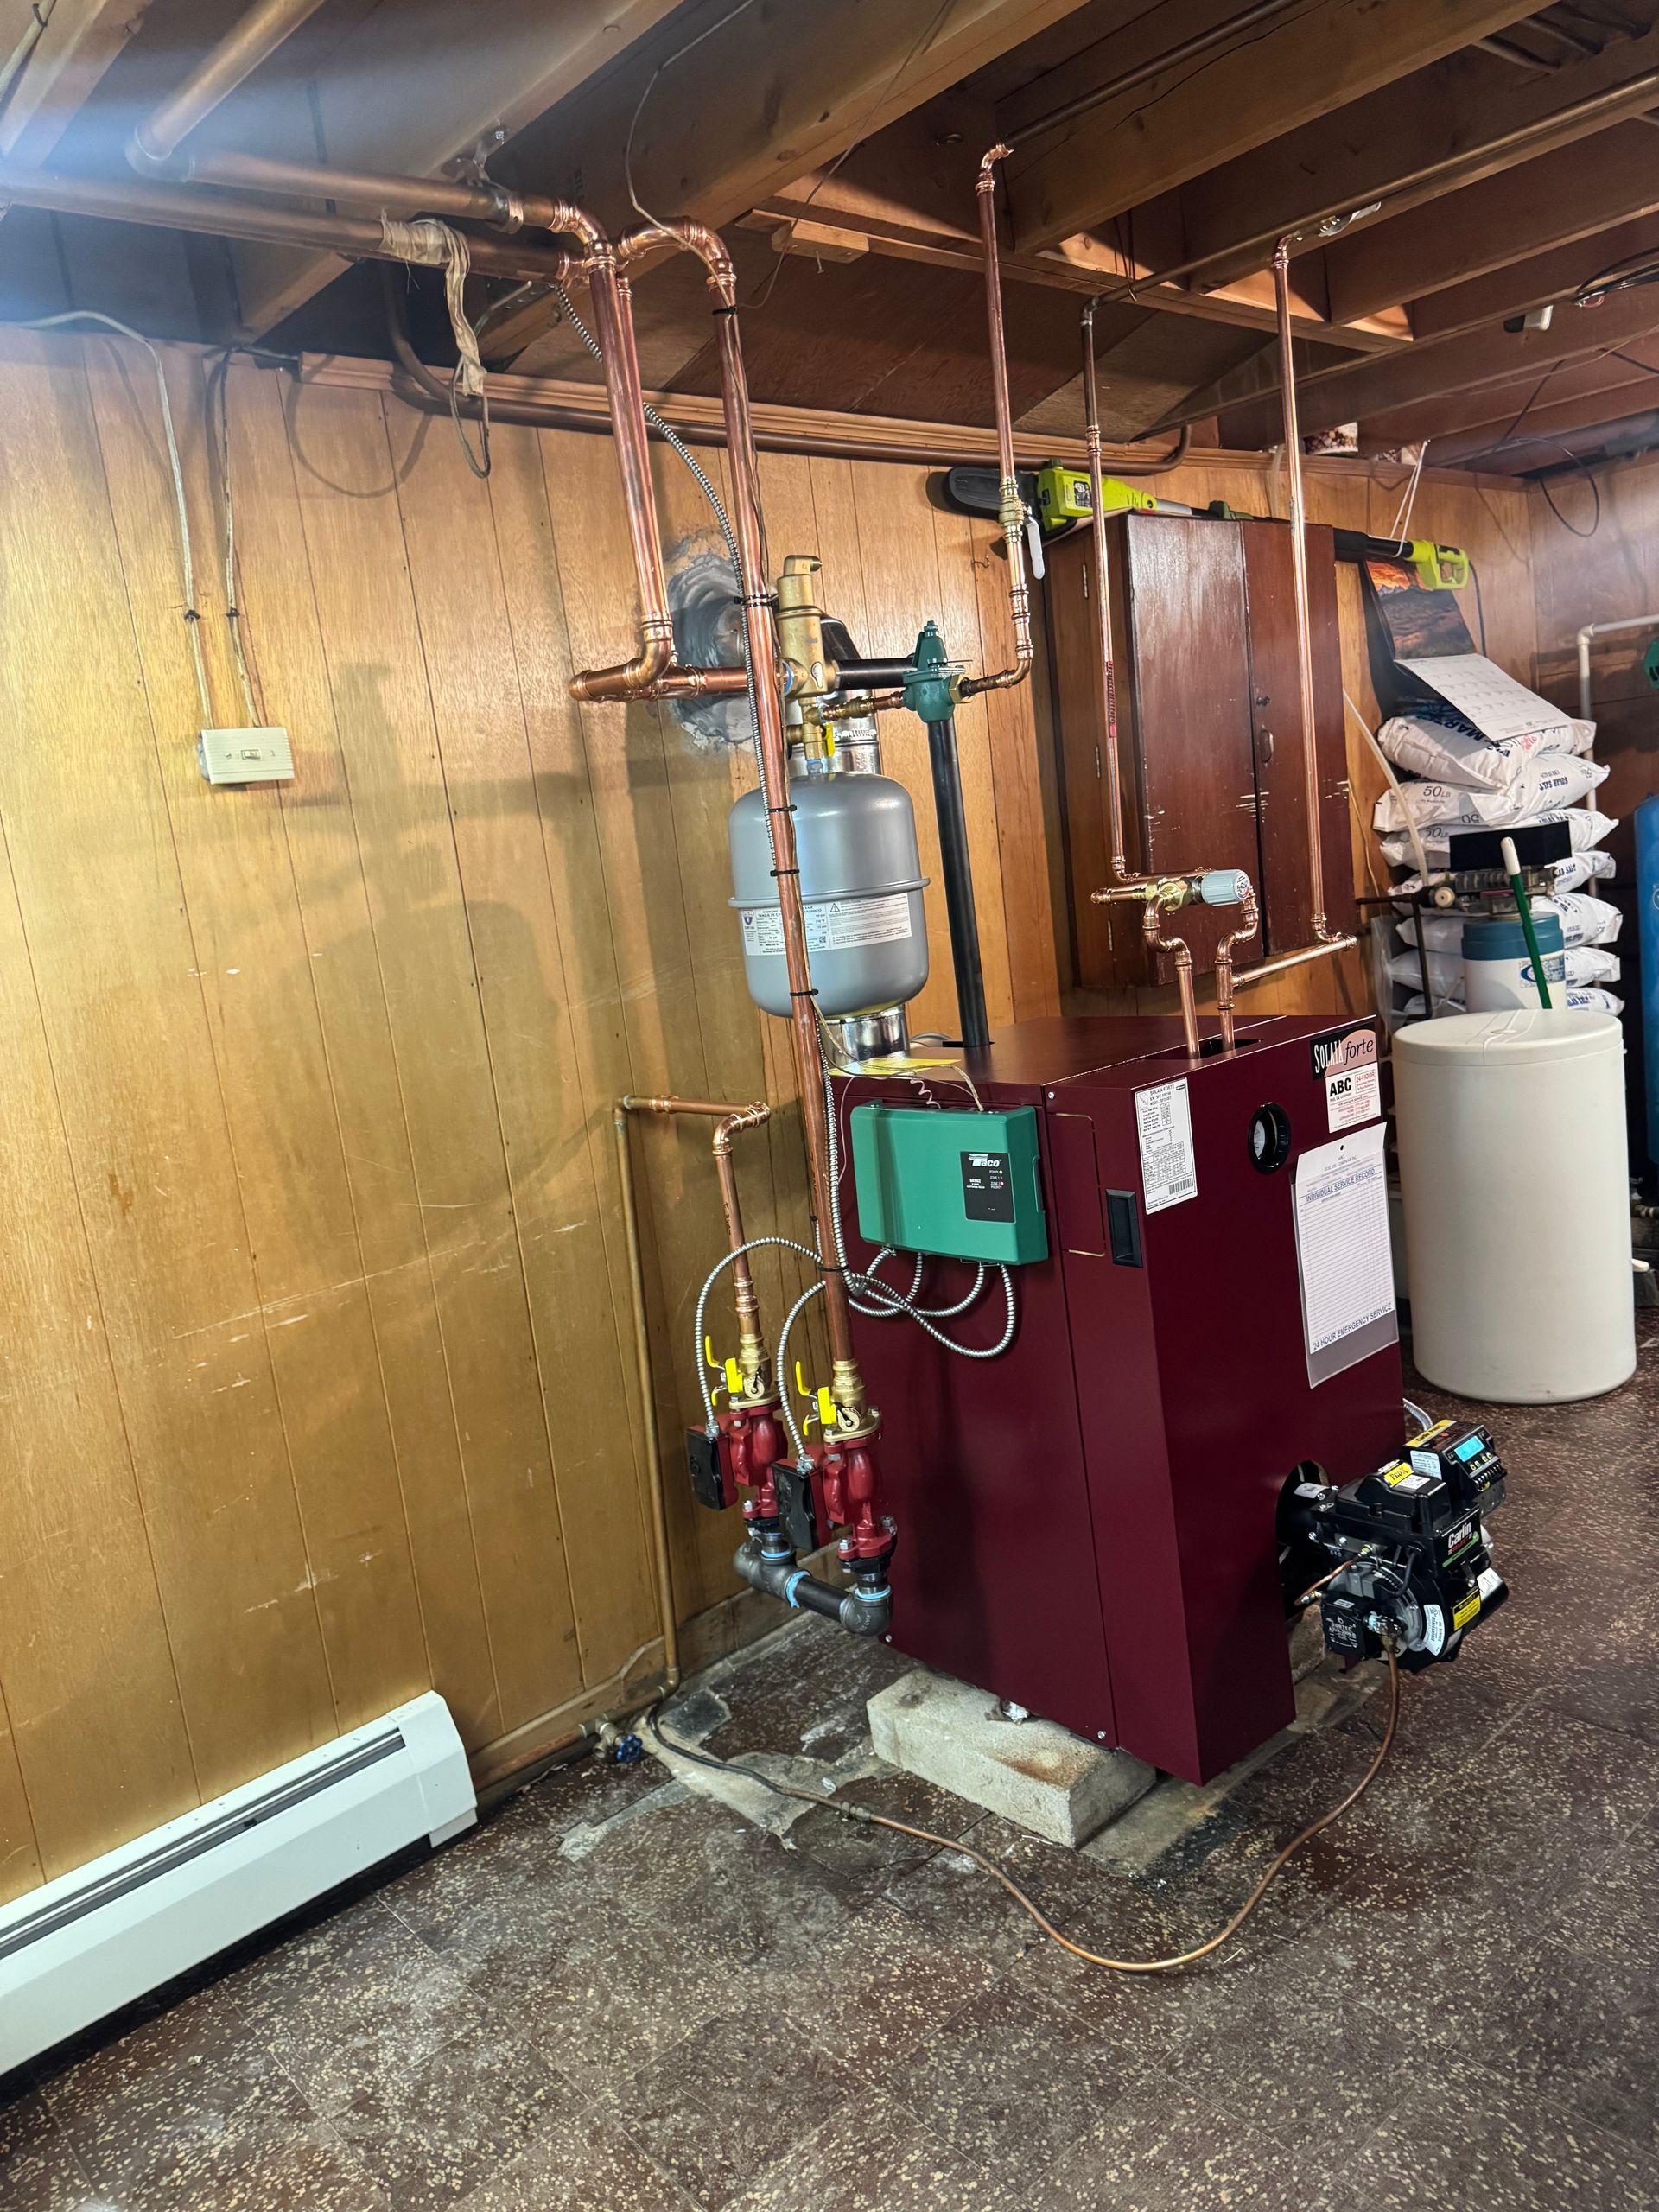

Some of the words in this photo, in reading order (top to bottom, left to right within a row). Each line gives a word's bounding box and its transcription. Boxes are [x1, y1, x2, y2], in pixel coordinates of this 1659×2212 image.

[1343, 1039, 1374, 1065] forte
[1329, 1077, 1352, 1097] ABC
[968, 1153, 1000, 1167] Taco
[1306, 1187, 1334, 1203] INDIVIDUAL
[1334, 1178, 1355, 1192] SERVICE
[1355, 1168, 1376, 1183] RECORD
[1313, 1341, 1320, 1351] 24
[1320, 1332, 1337, 1345] HOUR
[1337, 1315, 1370, 1338] EMERGENCY
[1370, 1302, 1392, 1319] SERVICE
[1448, 1522, 1471, 1548] Carlin
